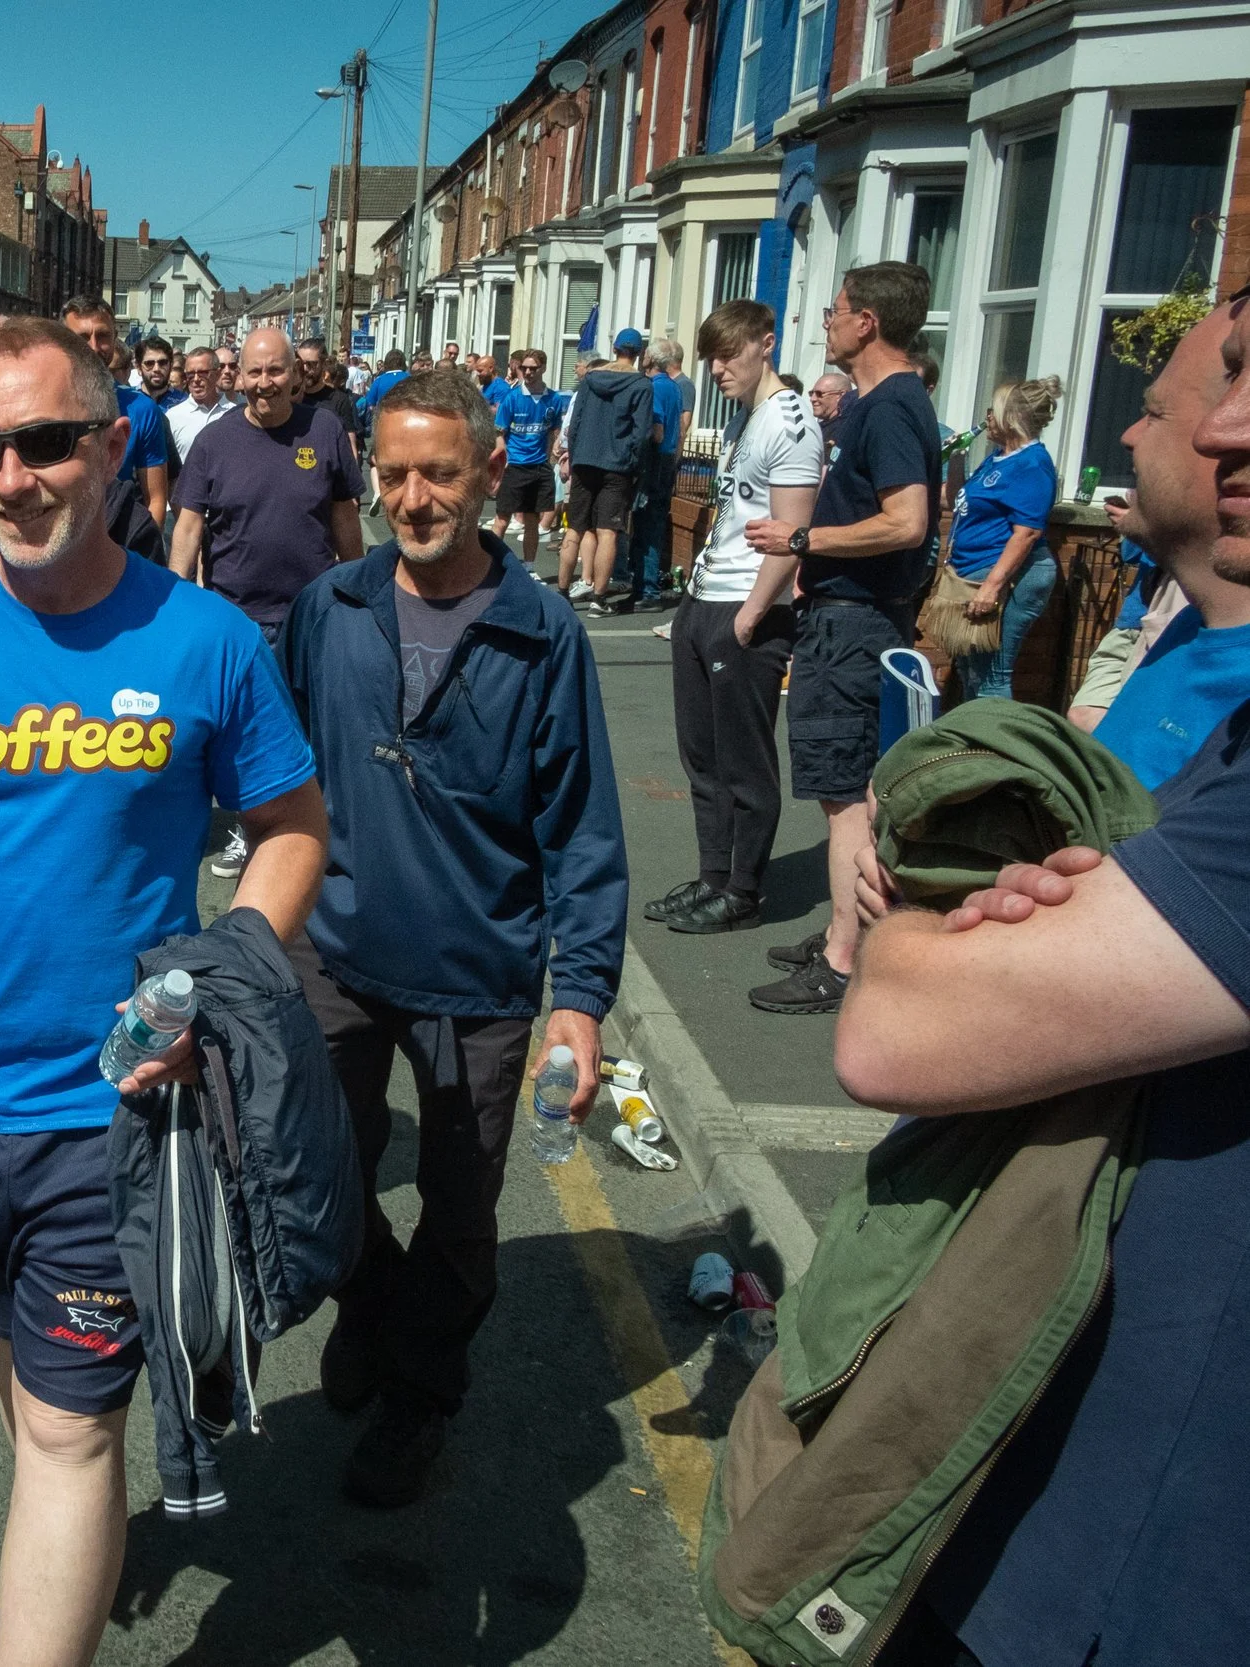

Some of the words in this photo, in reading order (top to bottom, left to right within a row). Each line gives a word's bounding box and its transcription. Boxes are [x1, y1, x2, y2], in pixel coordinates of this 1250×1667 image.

[118, 698, 134, 709] Up
[135, 698, 154, 709] The
[55, 1289, 90, 1304] PAUL
[92, 1290, 104, 1302] &
